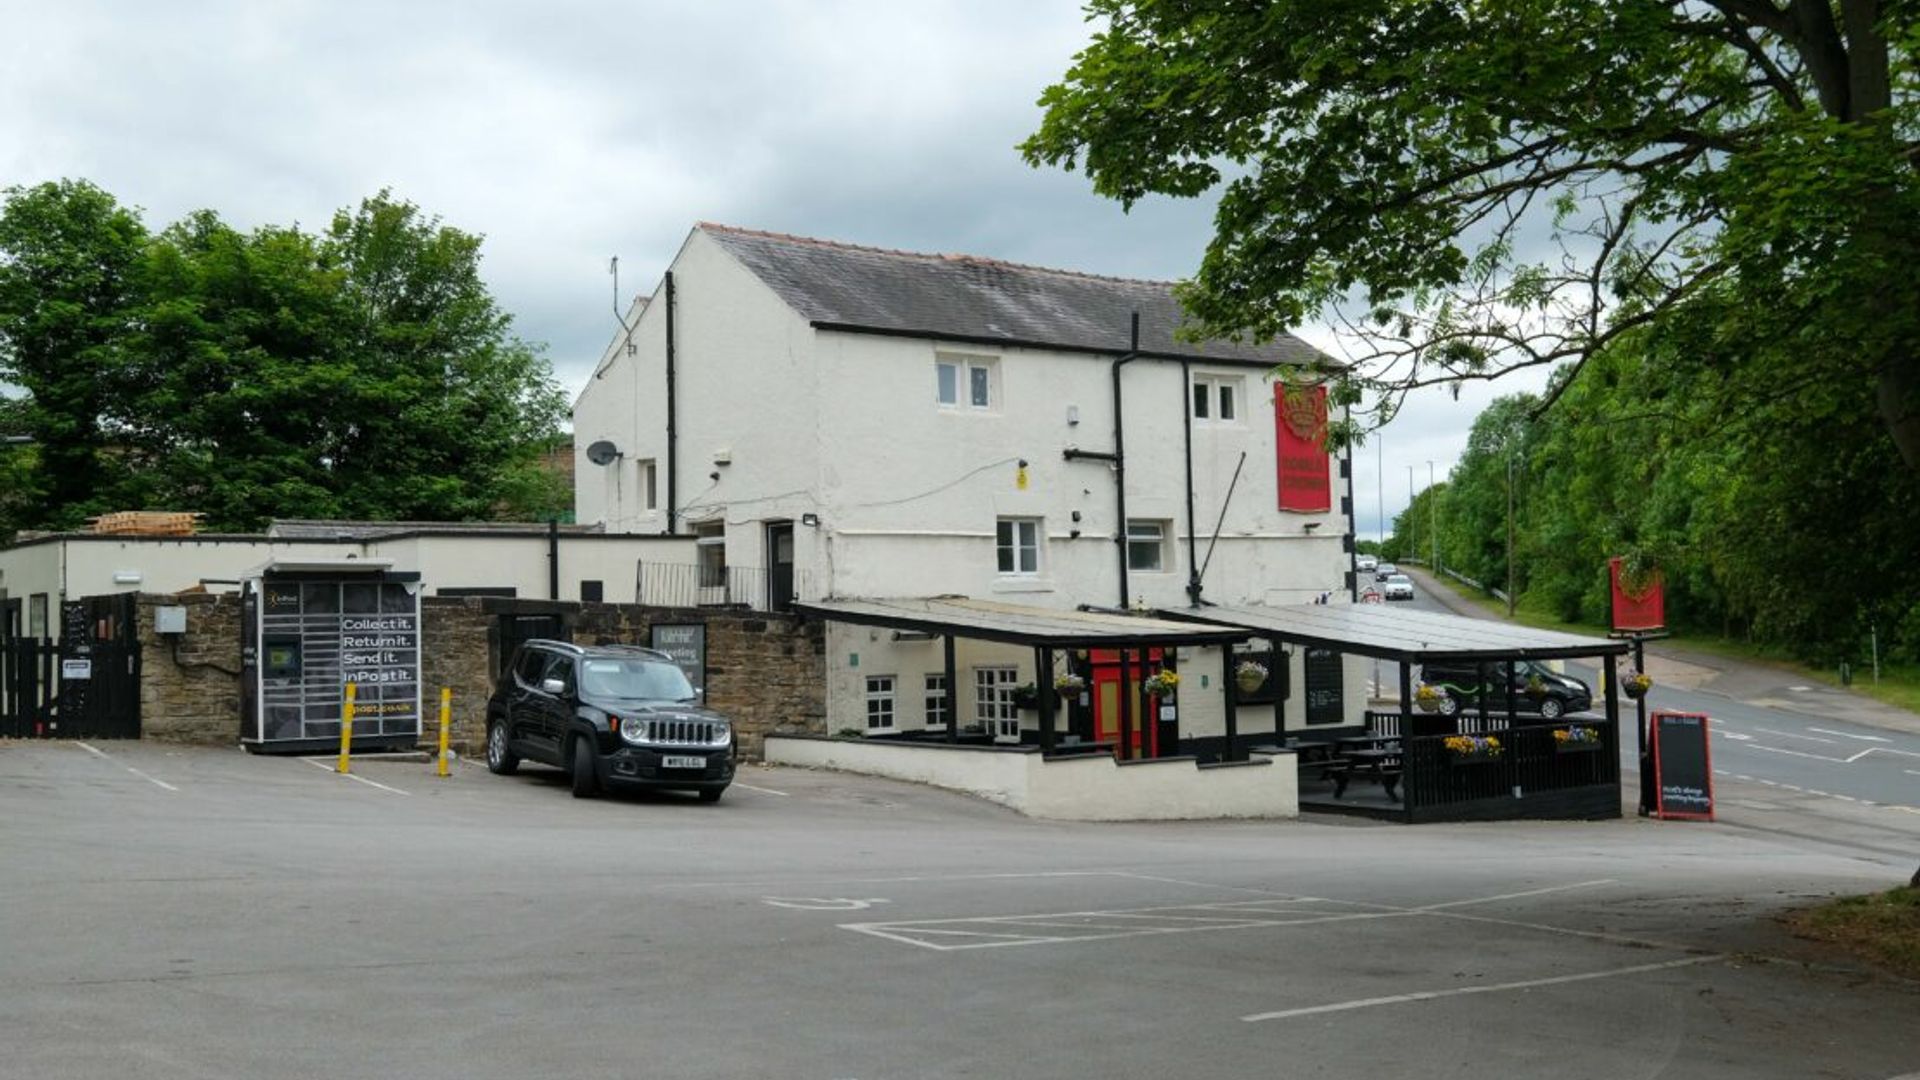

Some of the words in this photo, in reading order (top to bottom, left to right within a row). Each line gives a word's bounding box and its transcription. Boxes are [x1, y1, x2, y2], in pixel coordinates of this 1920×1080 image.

[343, 619, 395, 630] Collect
[397, 618, 412, 629] it.
[343, 636, 396, 647] Return
[396, 635, 411, 646] it.
[343, 653, 380, 664] Send
[384, 652, 398, 663] it.
[343, 670, 398, 682] InPost
[398, 669, 412, 681] it.
[353, 703, 411, 714] post.co.uk
